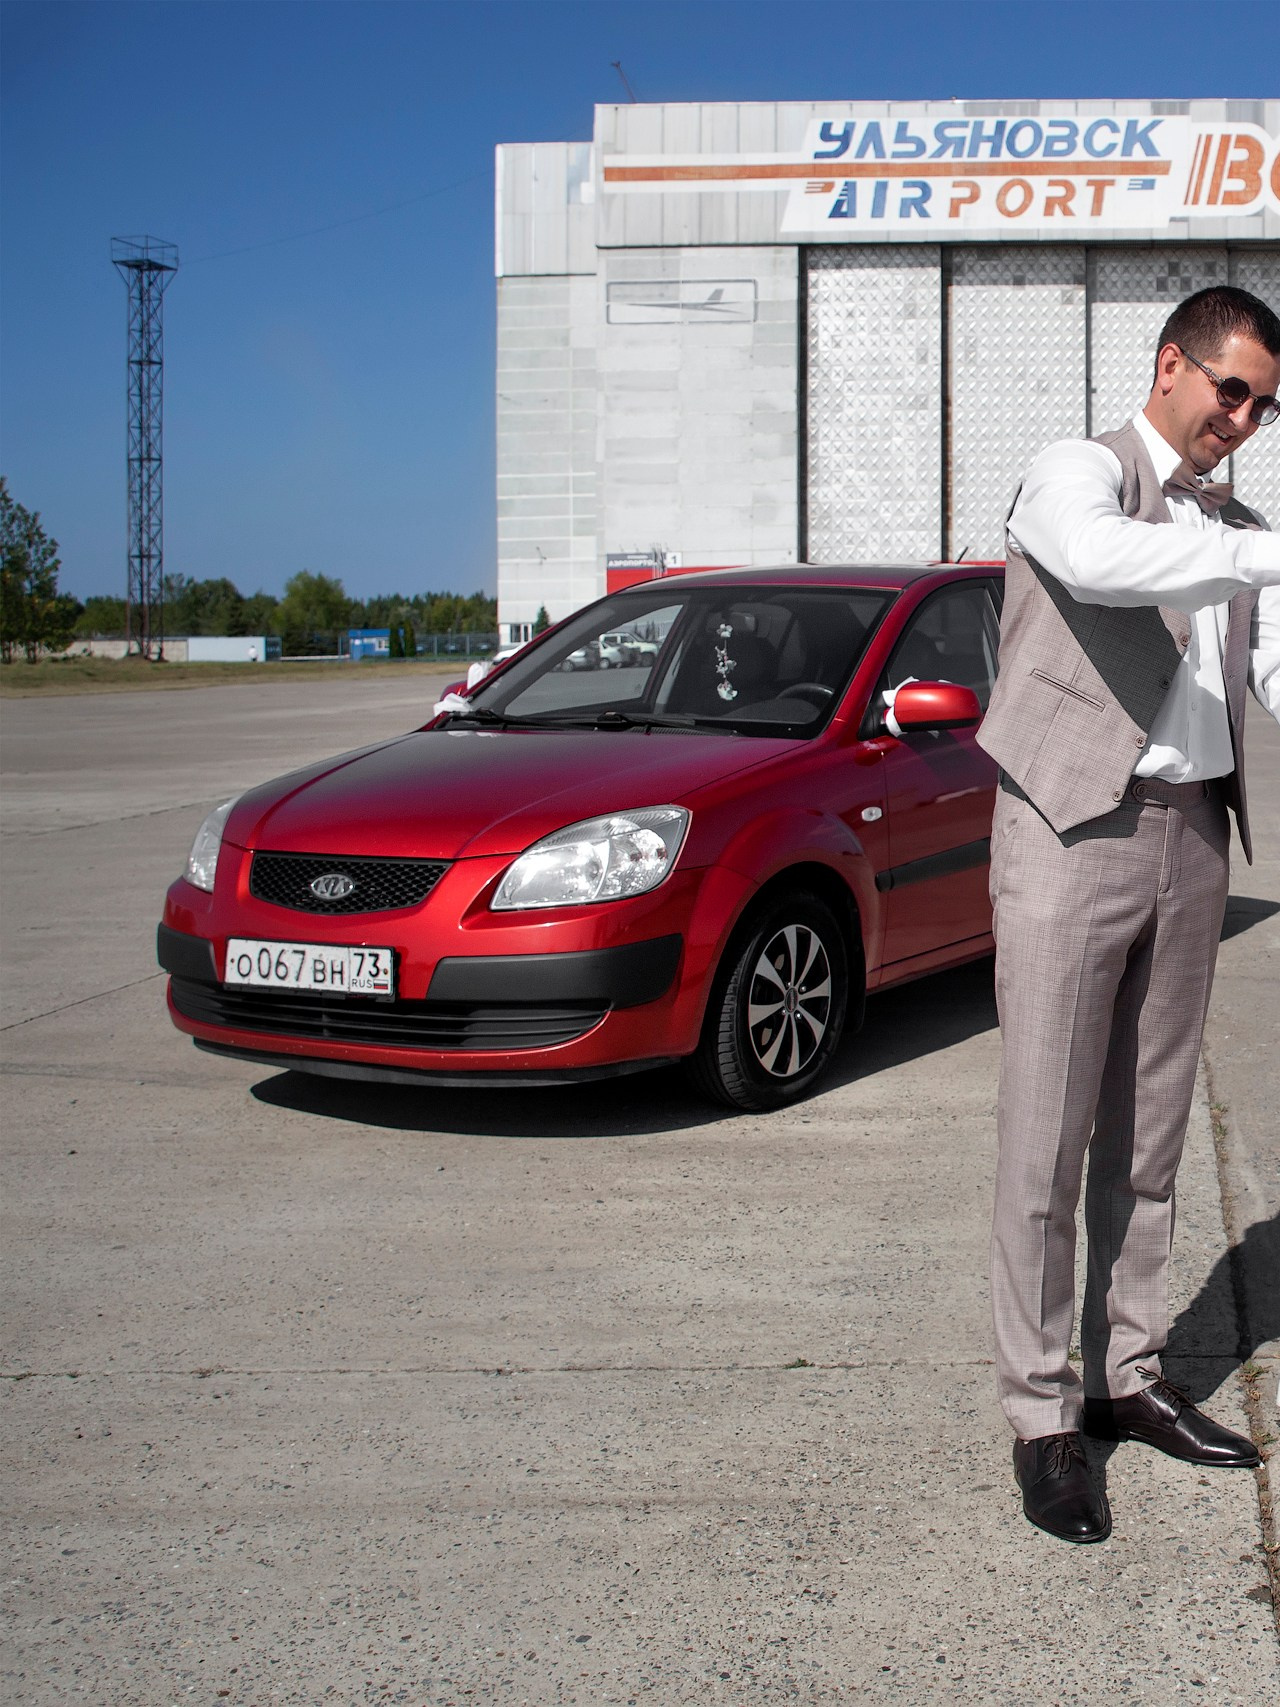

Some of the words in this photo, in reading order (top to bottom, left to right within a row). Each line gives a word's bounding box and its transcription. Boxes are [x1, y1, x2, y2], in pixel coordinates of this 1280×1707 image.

[814, 119, 1165, 160] УЛЬЯНОВСК
[828, 178, 1116, 219] AIRPORT
[353, 952, 381, 978] 73
[351, 978, 373, 989] RUS
